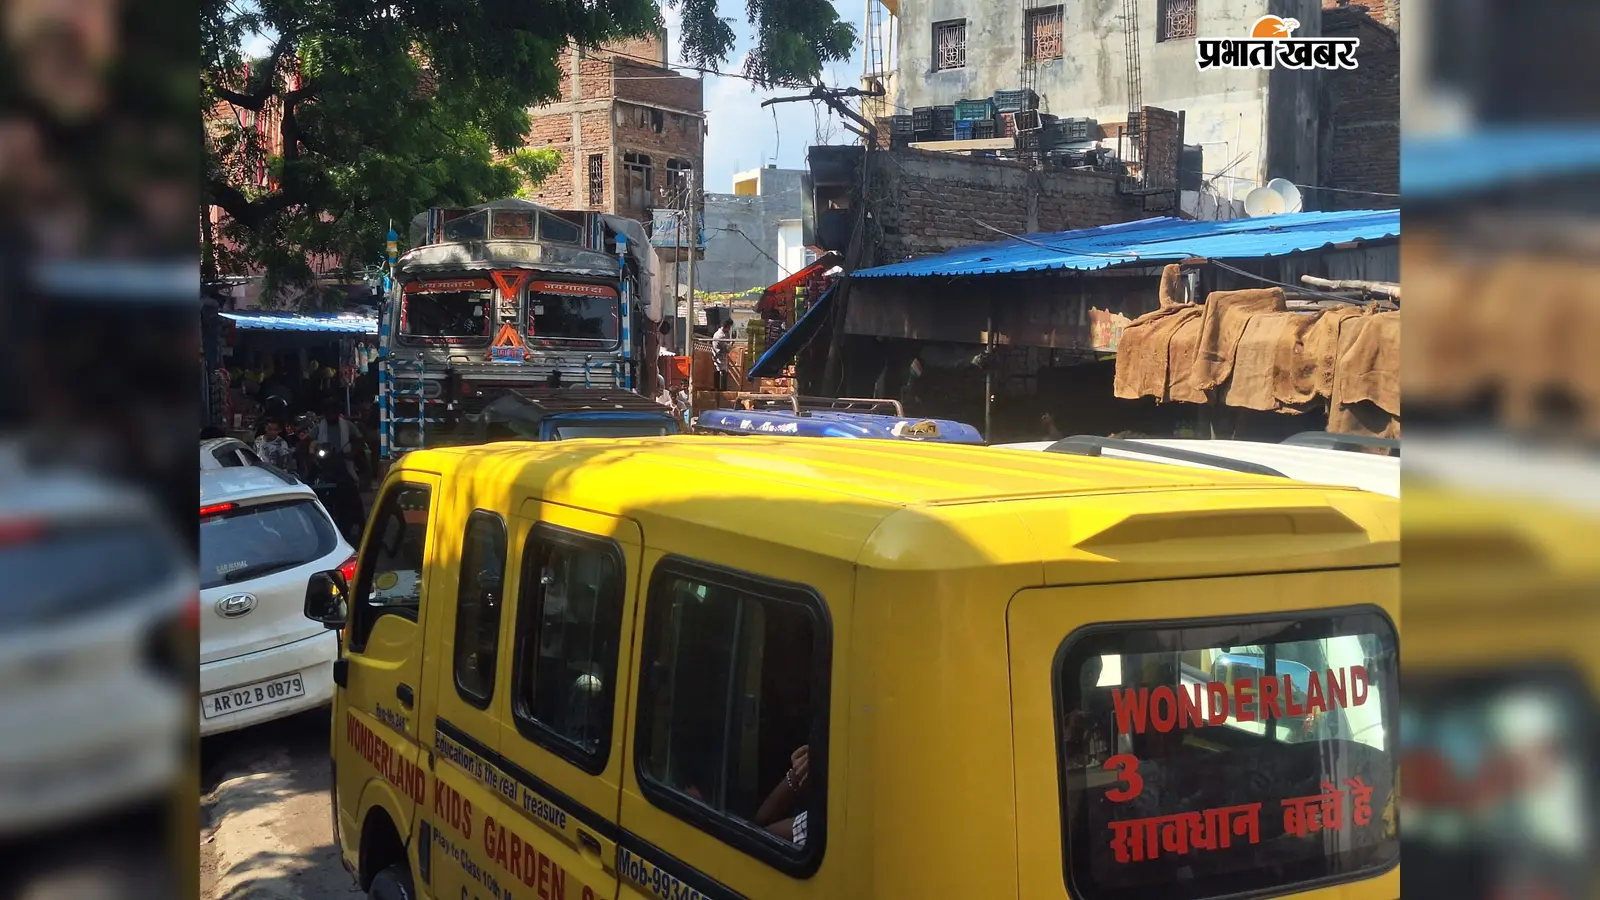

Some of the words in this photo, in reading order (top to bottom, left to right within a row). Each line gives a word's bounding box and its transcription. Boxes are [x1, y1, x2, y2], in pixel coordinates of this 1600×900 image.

[214, 695, 231, 712] AR
[233, 690, 253, 707] 02
[254, 687, 264, 702] B
[266, 678, 301, 698] 0879
[1112, 664, 1369, 735] WONDERLAND
[346, 710, 426, 806] WONDERLAND
[434, 777, 472, 840] KIDS
[483, 814, 567, 900] GARDEN
[435, 730, 475, 773] Education
[475, 755, 483, 778] is
[484, 765, 498, 789] the
[499, 777, 518, 801] real
[523, 787, 567, 830] treasure
[1102, 753, 1144, 802] 3
[433, 826, 450, 855] Play
[450, 842, 460, 861] to
[460, 848, 481, 882] Class
[482, 870, 500, 899] 10th
[1108, 802, 1263, 863] सावधान
